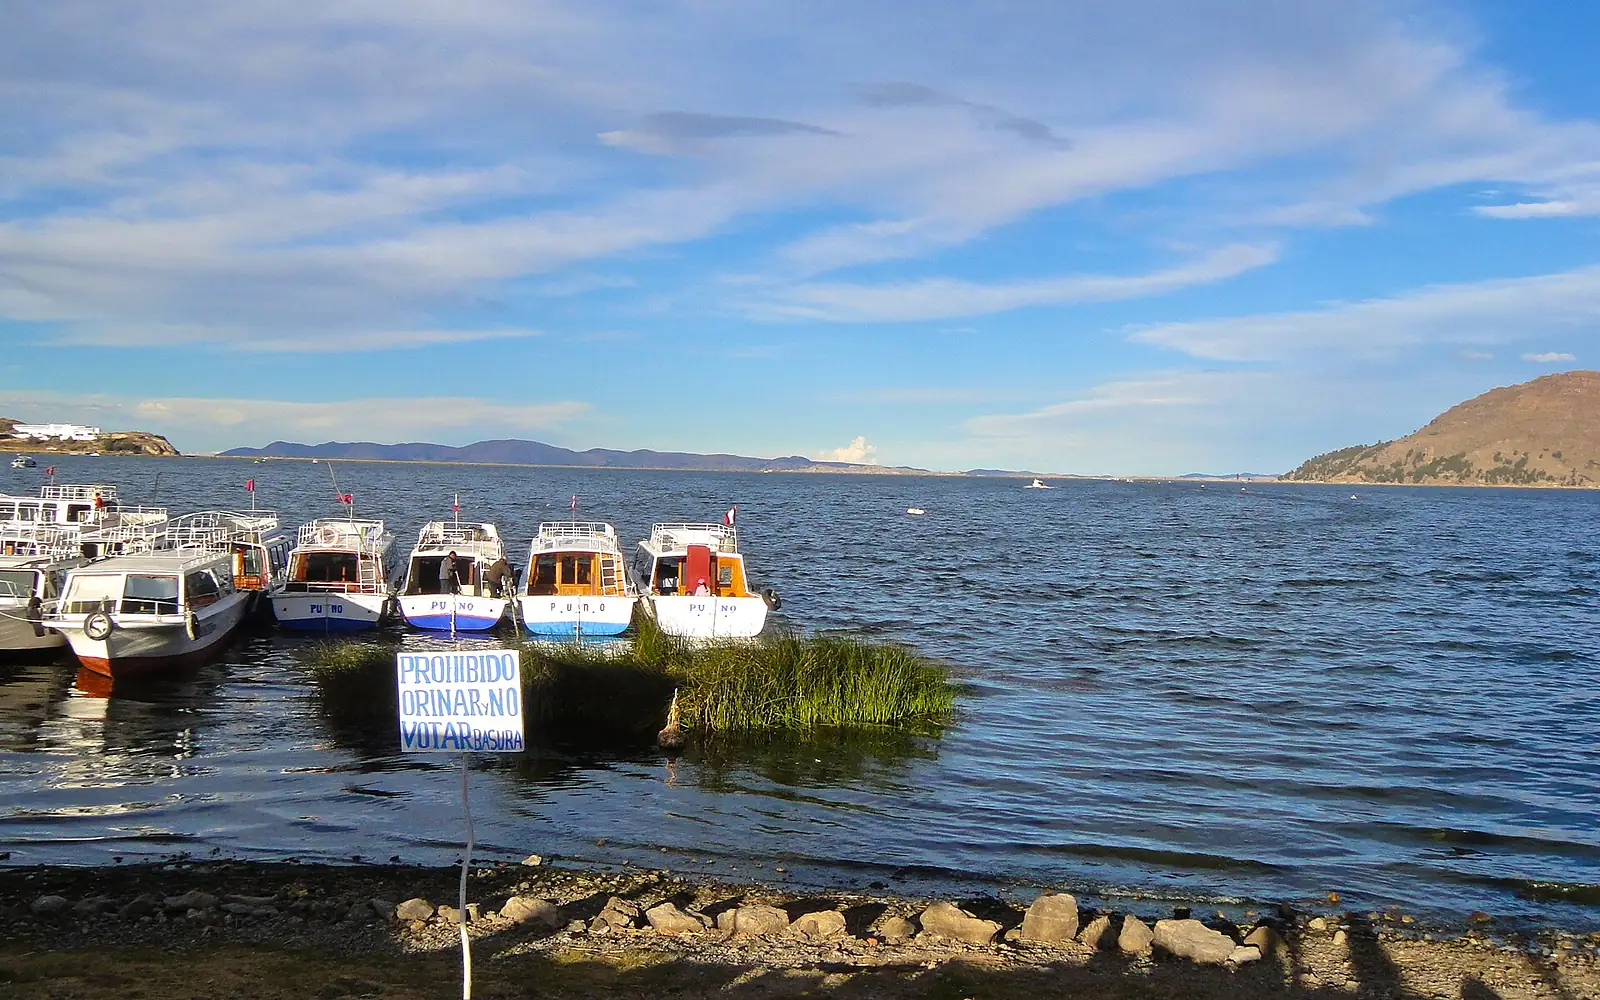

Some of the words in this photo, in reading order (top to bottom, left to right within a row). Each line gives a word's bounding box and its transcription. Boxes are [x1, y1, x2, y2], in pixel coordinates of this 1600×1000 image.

[399, 653, 515, 684] PROHIBIDO
[402, 688, 483, 717] ORINAR
[488, 687, 519, 717] NO
[401, 720, 475, 750] VOTAR
[473, 728, 523, 751] BASURA
